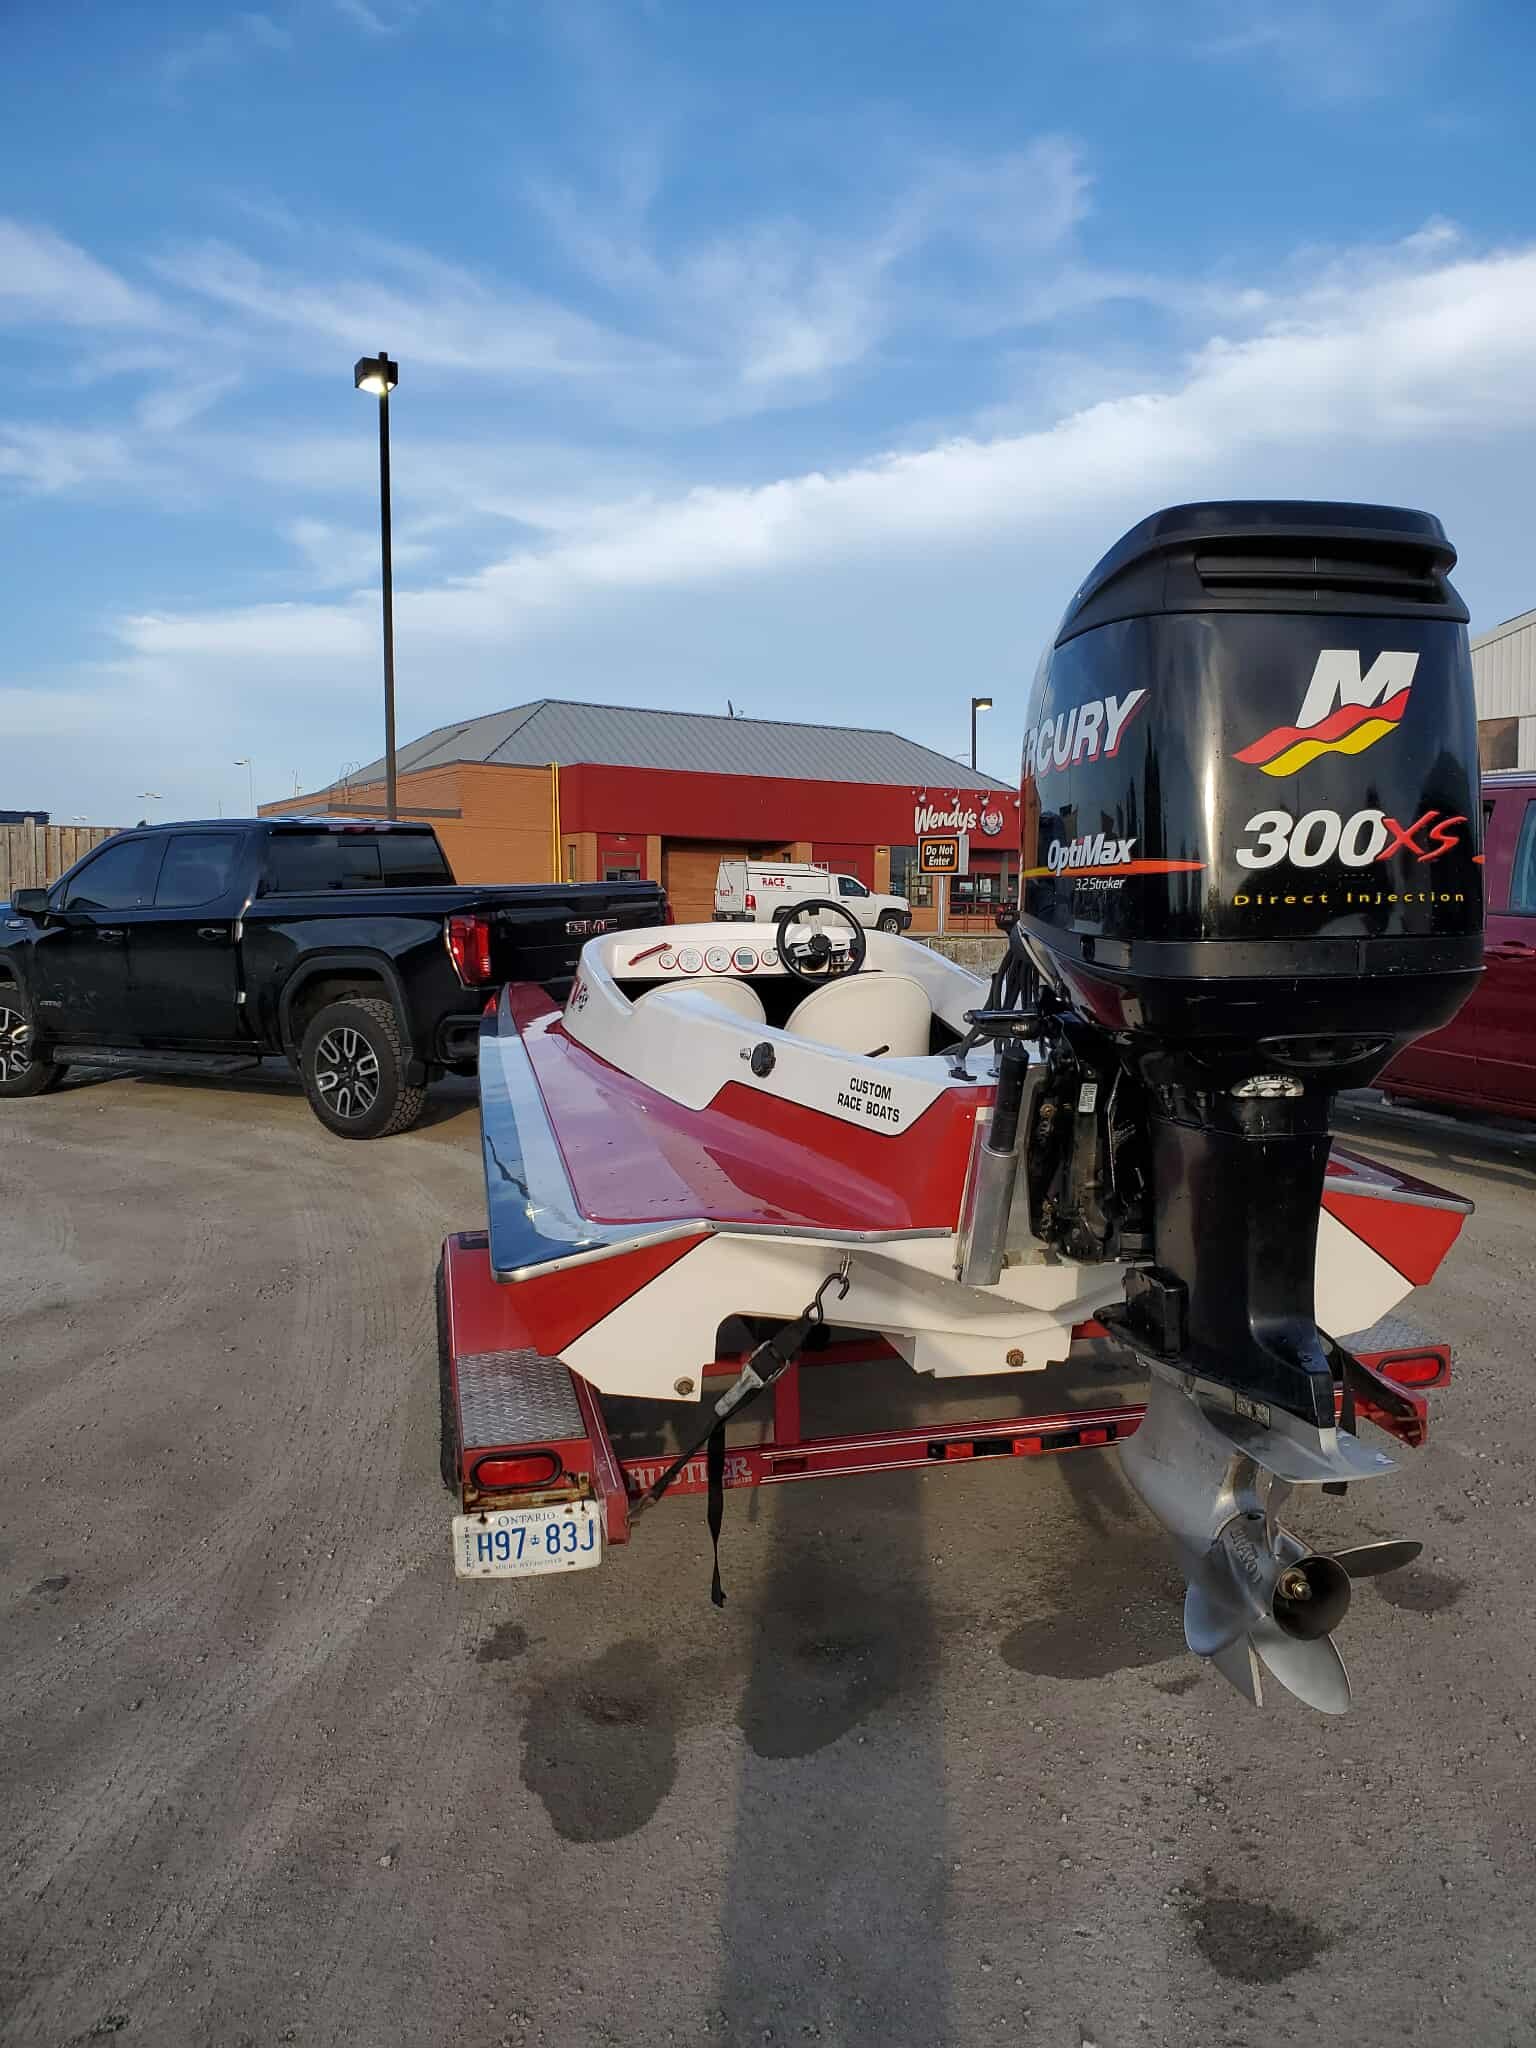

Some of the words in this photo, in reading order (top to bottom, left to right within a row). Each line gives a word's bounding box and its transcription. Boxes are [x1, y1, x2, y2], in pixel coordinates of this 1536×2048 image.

[914, 802, 977, 835] Wendy's
[926, 845, 937, 856] Do
[939, 844, 954, 855] Not
[1048, 832, 1137, 876] OptiMax
[928, 856, 950, 866] Enter
[762, 877, 785, 887] RACE
[1088, 876, 1126, 891] Stroker
[1233, 893, 1329, 906] Direct
[1346, 891, 1465, 905] Injection
[565, 918, 618, 935] GMC
[850, 1077, 892, 1101] CUSTOM
[837, 1092, 862, 1111] RACE
[866, 1101, 900, 1123] BOATS
[477, 1527, 526, 1562] H97
[545, 1519, 594, 1555] 83J
